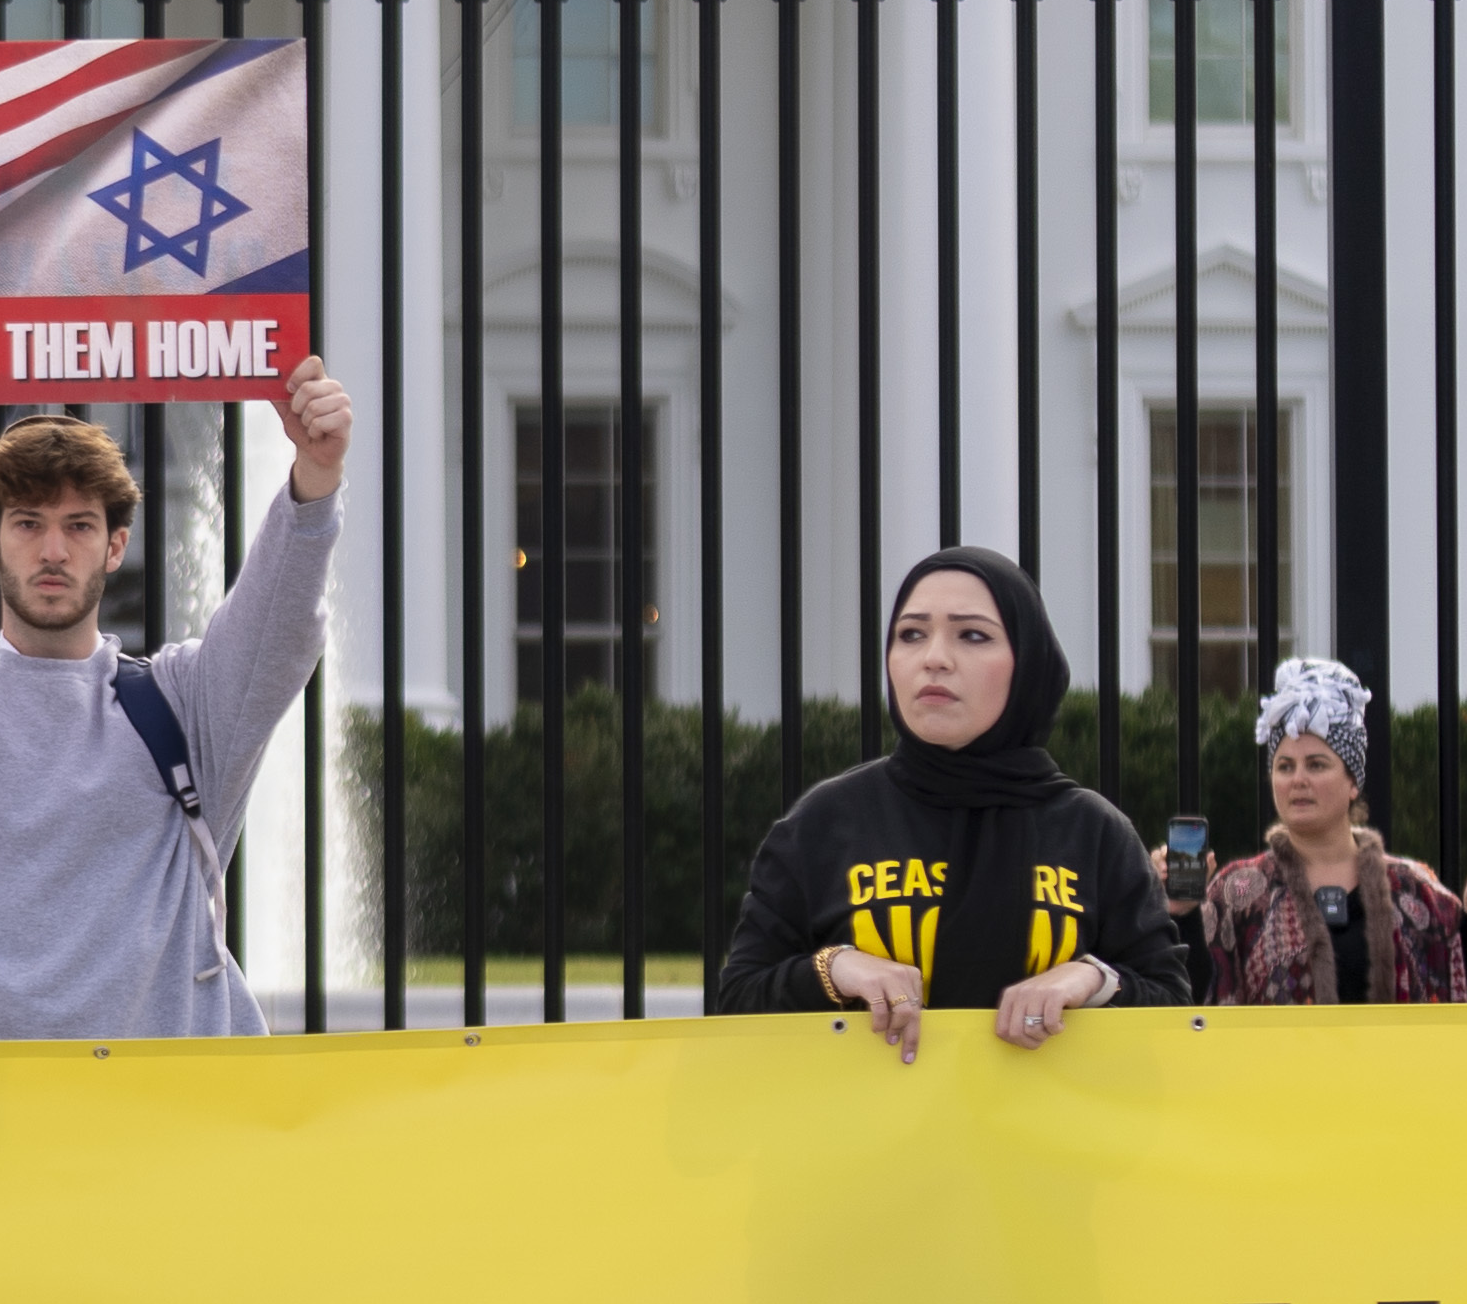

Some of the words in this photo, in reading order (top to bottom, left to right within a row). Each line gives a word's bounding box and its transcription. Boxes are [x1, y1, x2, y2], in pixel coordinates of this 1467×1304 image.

[5, 322, 135, 381] THEM
[147, 320, 280, 379] HOME
[848, 858, 1085, 912] CEASRE
